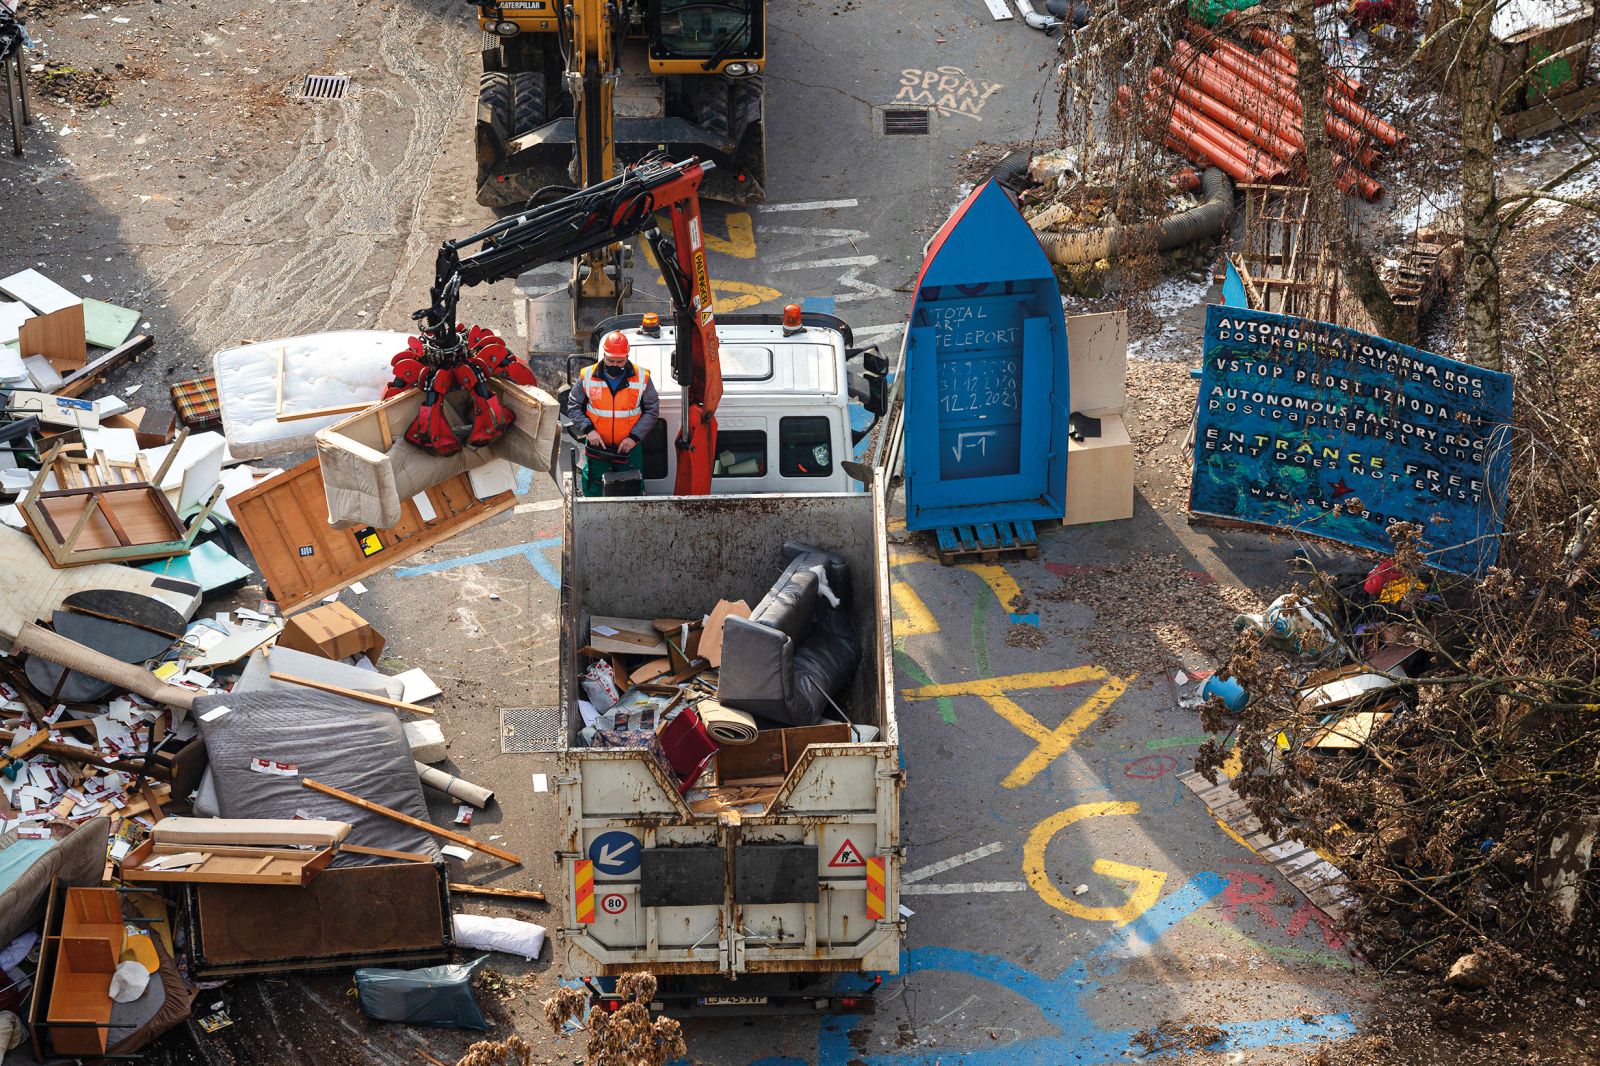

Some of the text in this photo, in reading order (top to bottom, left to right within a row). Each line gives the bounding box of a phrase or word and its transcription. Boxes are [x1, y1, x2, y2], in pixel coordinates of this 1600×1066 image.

[500, 1, 541, 9] CATERPILLAR
[899, 68, 1003, 99] SPRAY
[895, 86, 986, 114] MAN
[695, 254, 708, 305] PALFINGER
[934, 319, 966, 331] ART
[935, 306, 987, 320] TOTAL
[936, 328, 1016, 347] TELEPORT
[1353, 343, 1438, 377] OVARNA
[1445, 371, 1482, 388] ROG
[1216, 358, 1283, 378] VSTOP
[1296, 370, 1361, 393] PROST
[1374, 387, 1448, 419] IZHODA
[1433, 379, 1481, 398] cona
[1209, 399, 1482, 461] postcapitalist zone
[1211, 386, 1484, 450] AUTONOMOUS FACTORY ROG
[1205, 441, 1482, 502] EXIT DOES NOT EXIST
[1206, 428, 1483, 492] ENTRANCE FREE
[608, 898, 622, 908] 80
